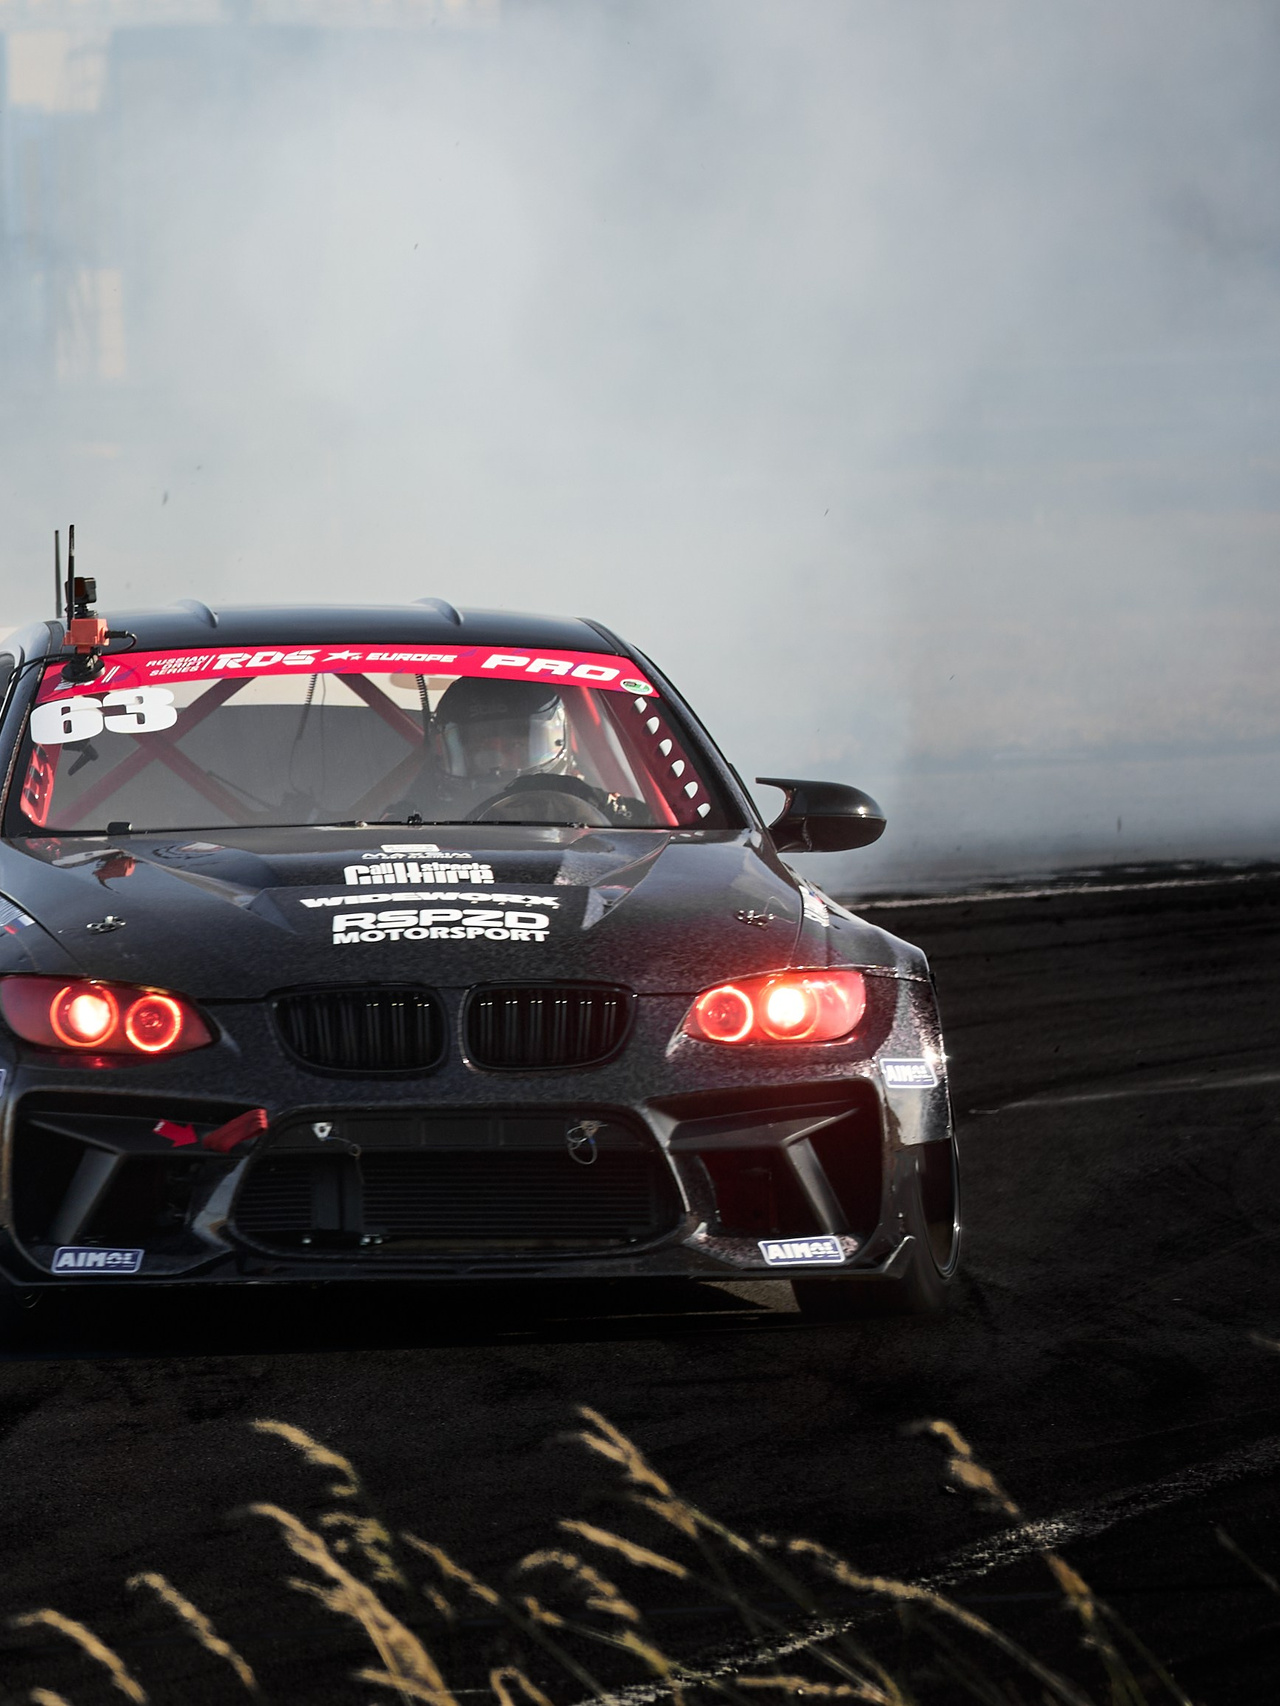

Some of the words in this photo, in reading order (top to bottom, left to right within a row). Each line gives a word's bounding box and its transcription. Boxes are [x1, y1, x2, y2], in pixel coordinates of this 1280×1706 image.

[145, 655, 209, 667] RUSSIAN
[212, 649, 323, 670] RDS
[365, 652, 457, 663] EUROPE
[481, 654, 620, 682] PRO
[149, 665, 200, 677] SERIES
[30, 687, 178, 745] 63
[299, 892, 560, 908] WIDEWORX
[332, 927, 550, 945] MOTORSPORT
